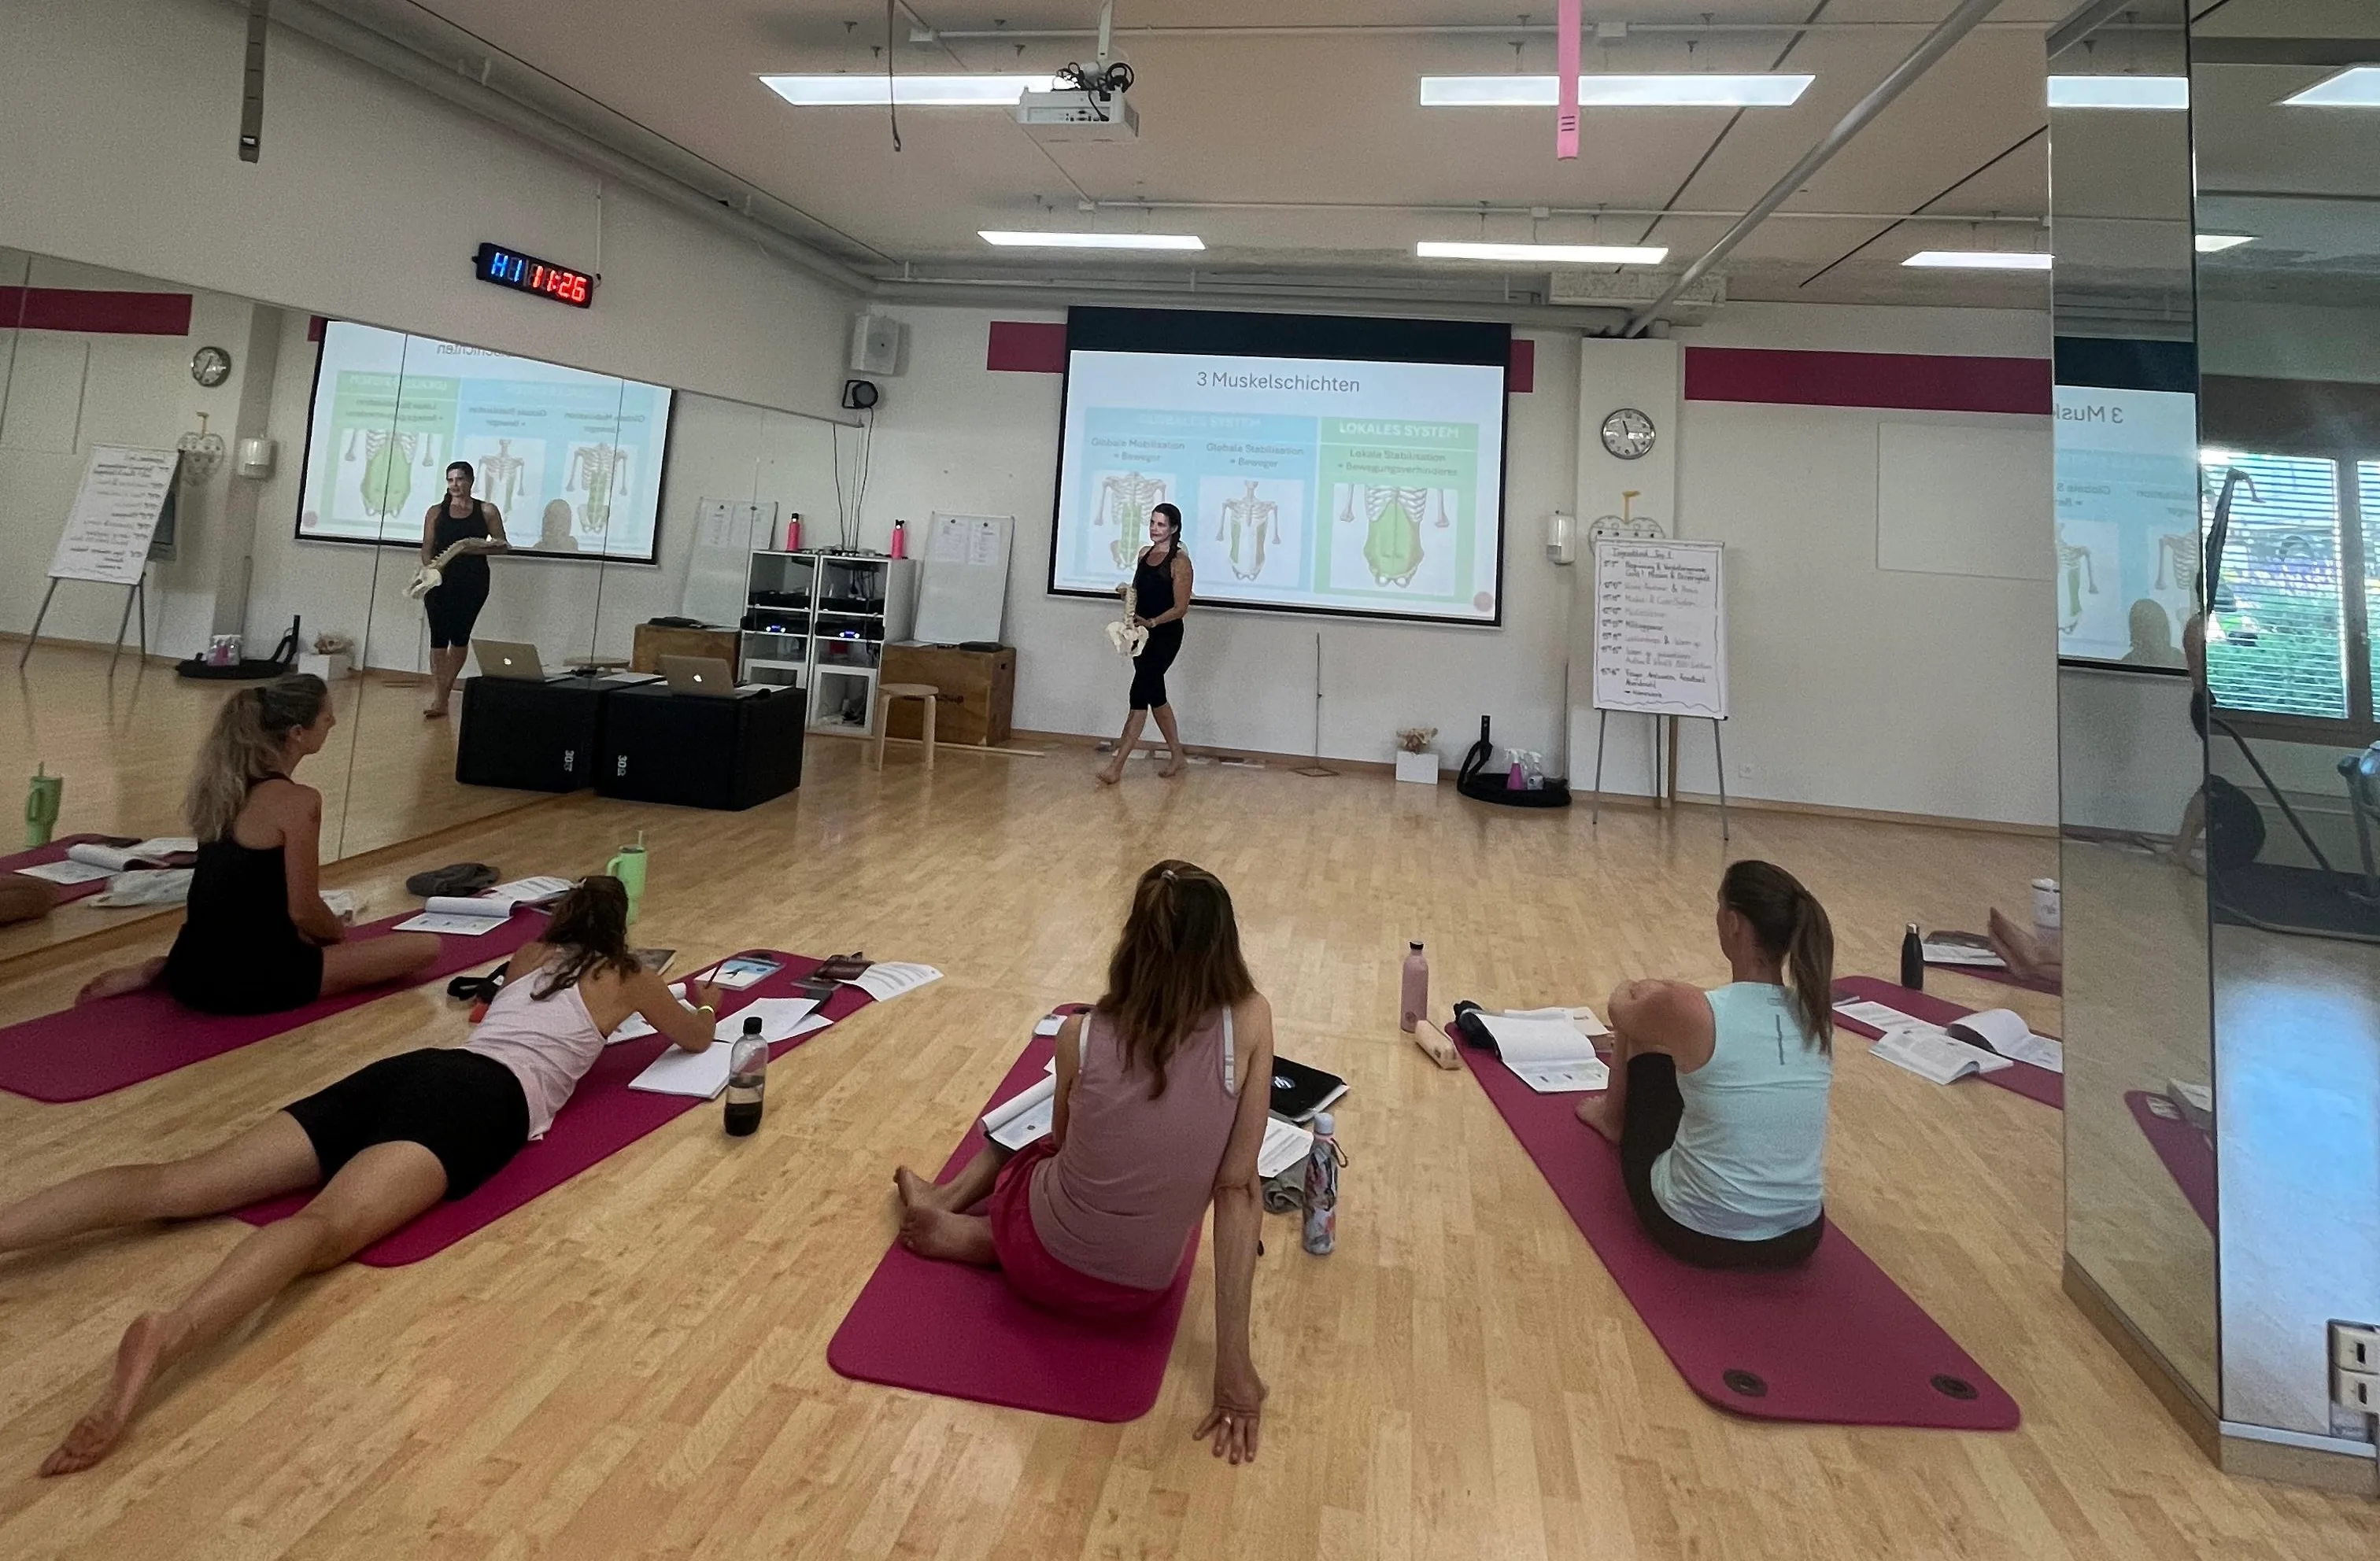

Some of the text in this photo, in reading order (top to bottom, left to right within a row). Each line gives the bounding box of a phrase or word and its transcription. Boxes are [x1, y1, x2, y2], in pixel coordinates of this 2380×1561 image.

[532, 264, 588, 302] 11:26
[1196, 371, 1360, 393] 3 Muskelschichten
[1339, 420, 1460, 439] LOKALES SYSTEM
[1091, 437, 1185, 451] Globale Mobilisation
[1206, 442, 1304, 456] Globale Stabilisation
[1122, 451, 1161, 463] Beweger
[1350, 449, 1447, 463] Lokale Stabilisation
[1238, 457, 1279, 470] Beweger
[1346, 462, 1458, 477] Bewegungsverhinderer
